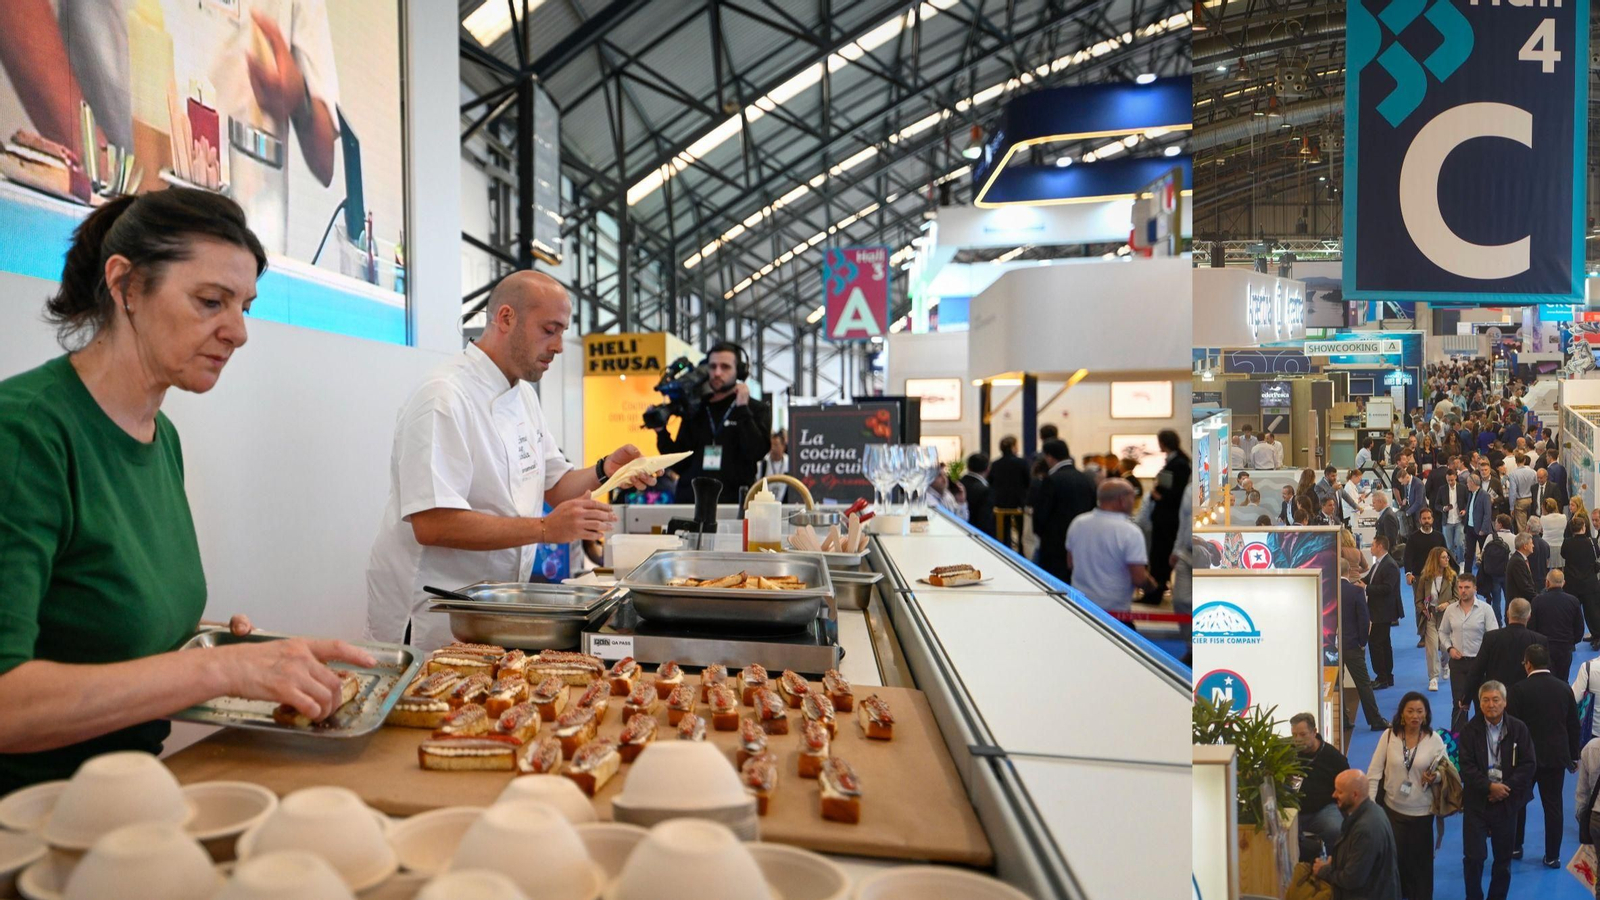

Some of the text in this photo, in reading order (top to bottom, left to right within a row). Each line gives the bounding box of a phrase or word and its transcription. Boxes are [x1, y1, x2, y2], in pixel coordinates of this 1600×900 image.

[1518, 18, 1562, 73] 4
[1399, 102, 1533, 280] C
[856, 248, 886, 263] Hall
[871, 263, 885, 281] 3
[832, 286, 881, 338] A
[588, 339, 638, 357] HELI
[1308, 343, 1378, 353] SHOWCOOKING
[589, 356, 660, 372] FRUSA
[799, 429, 824, 446] La
[800, 443, 857, 460] cocina
[800, 458, 862, 478] que cui
